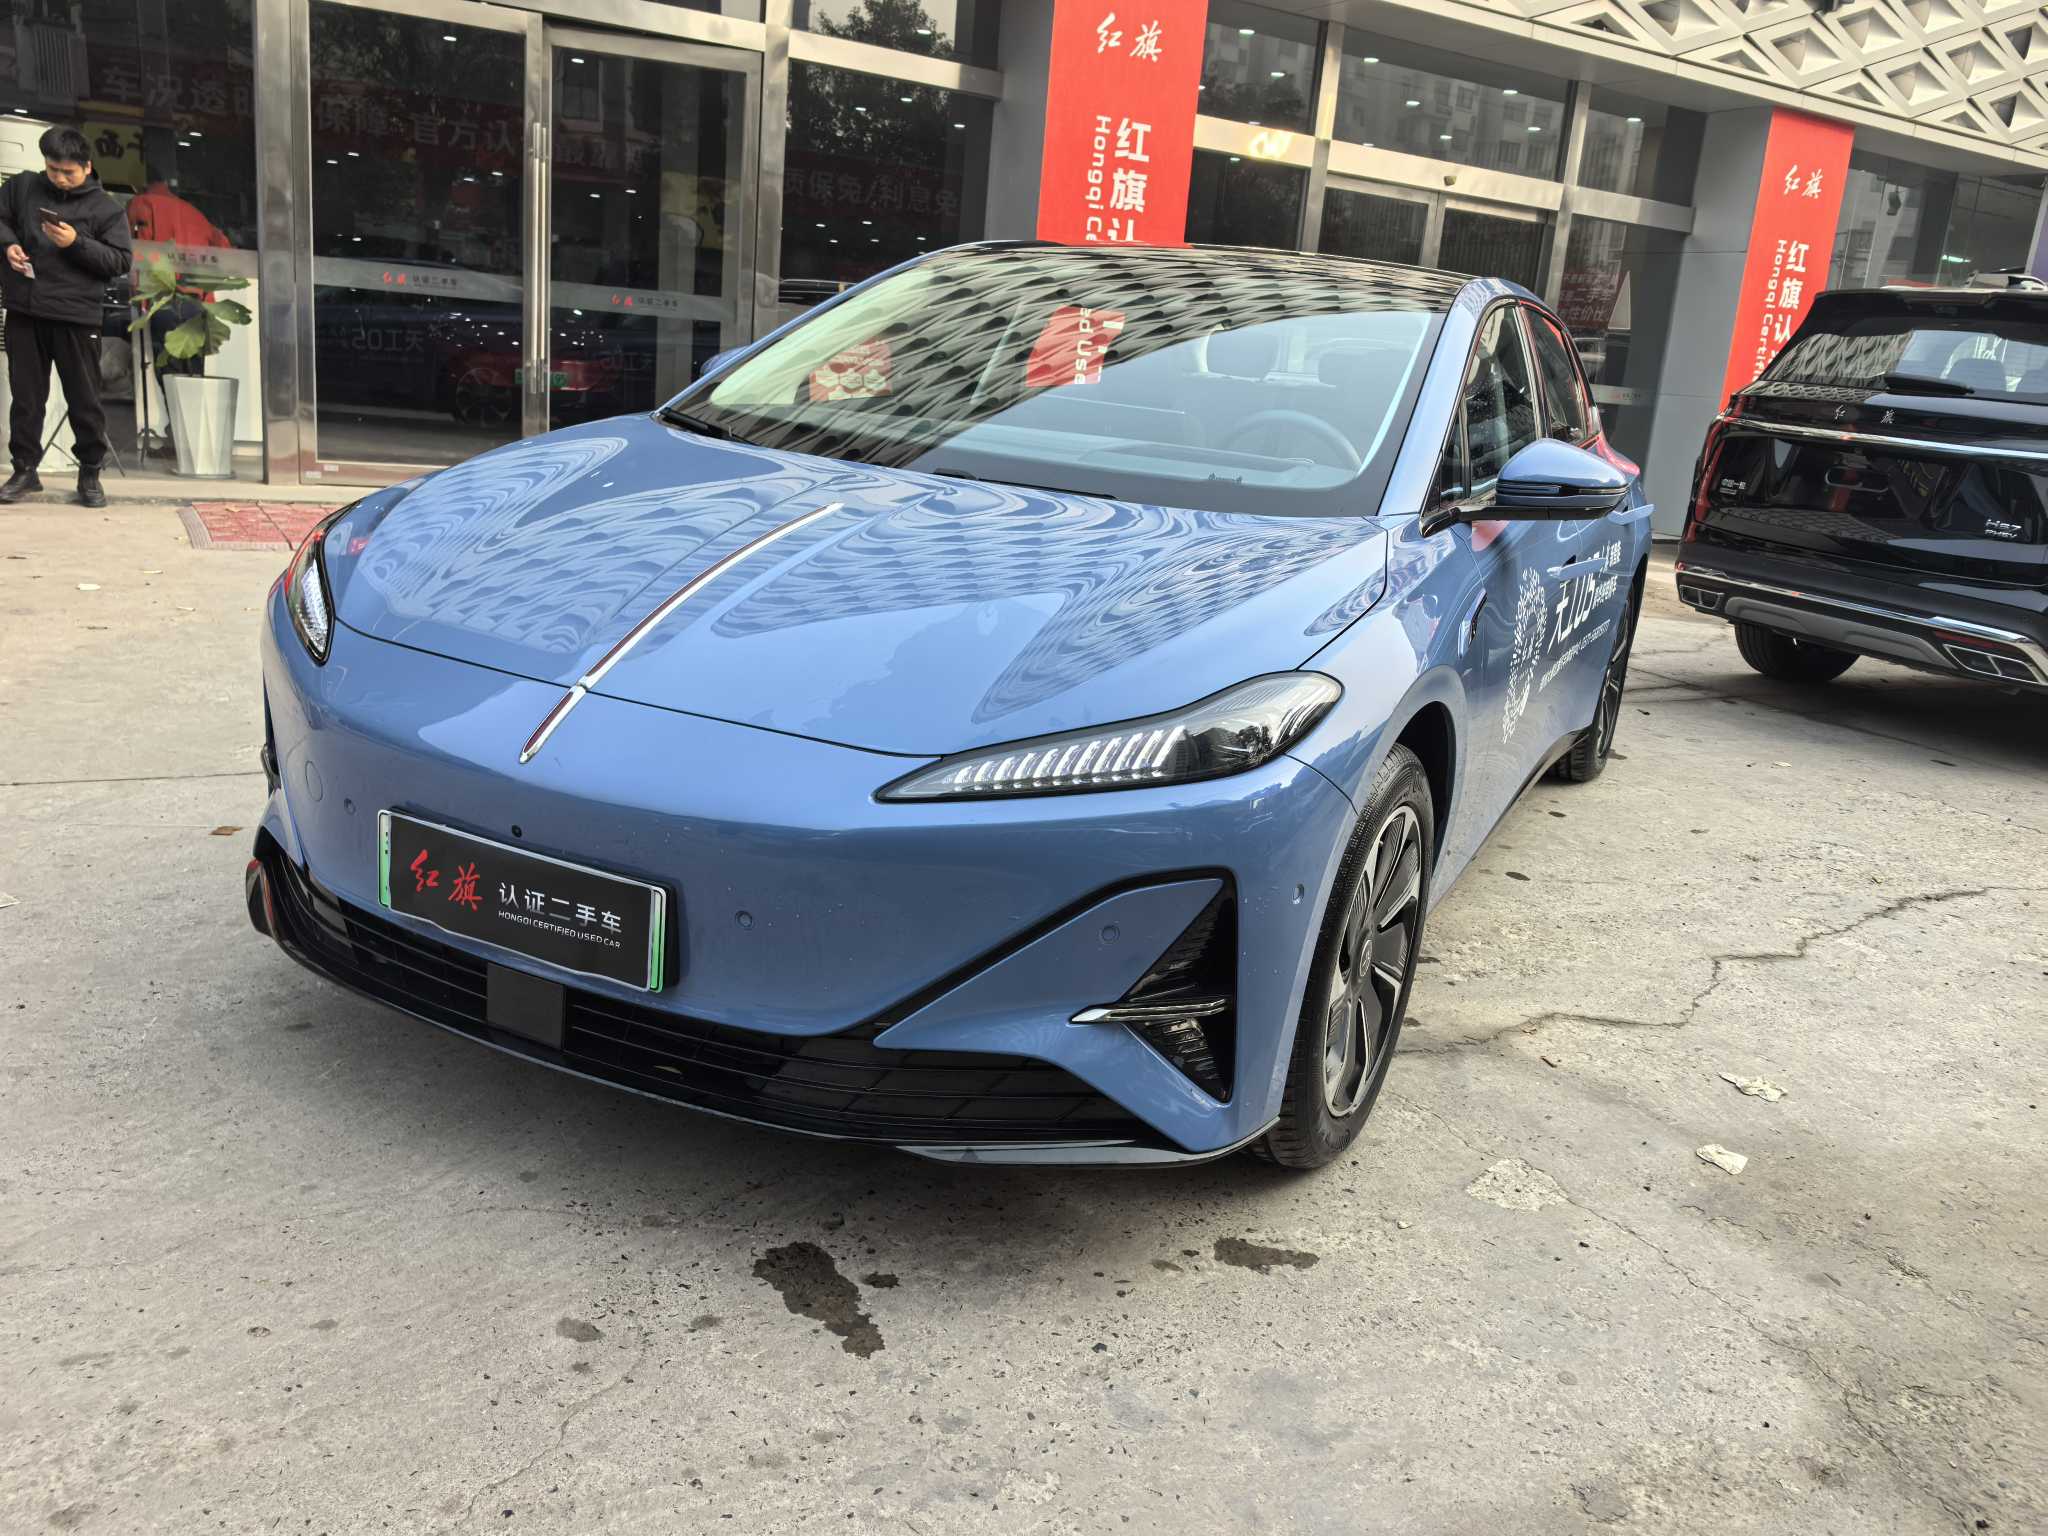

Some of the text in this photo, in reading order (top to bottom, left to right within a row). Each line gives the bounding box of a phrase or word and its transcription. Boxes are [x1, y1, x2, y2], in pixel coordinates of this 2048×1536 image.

[1096, 12, 1163, 63] 红旗
[1085, 115, 1112, 210] Hongqi
[1783, 164, 1823, 199] 红旗
[1765, 239, 1788, 309] Hongqi
[1768, 240, 1809, 363] 红旗认
[409, 848, 623, 935] 红旗 认证二手车
[498, 910, 621, 950] HONGQI CERTIFIED USED CAR
